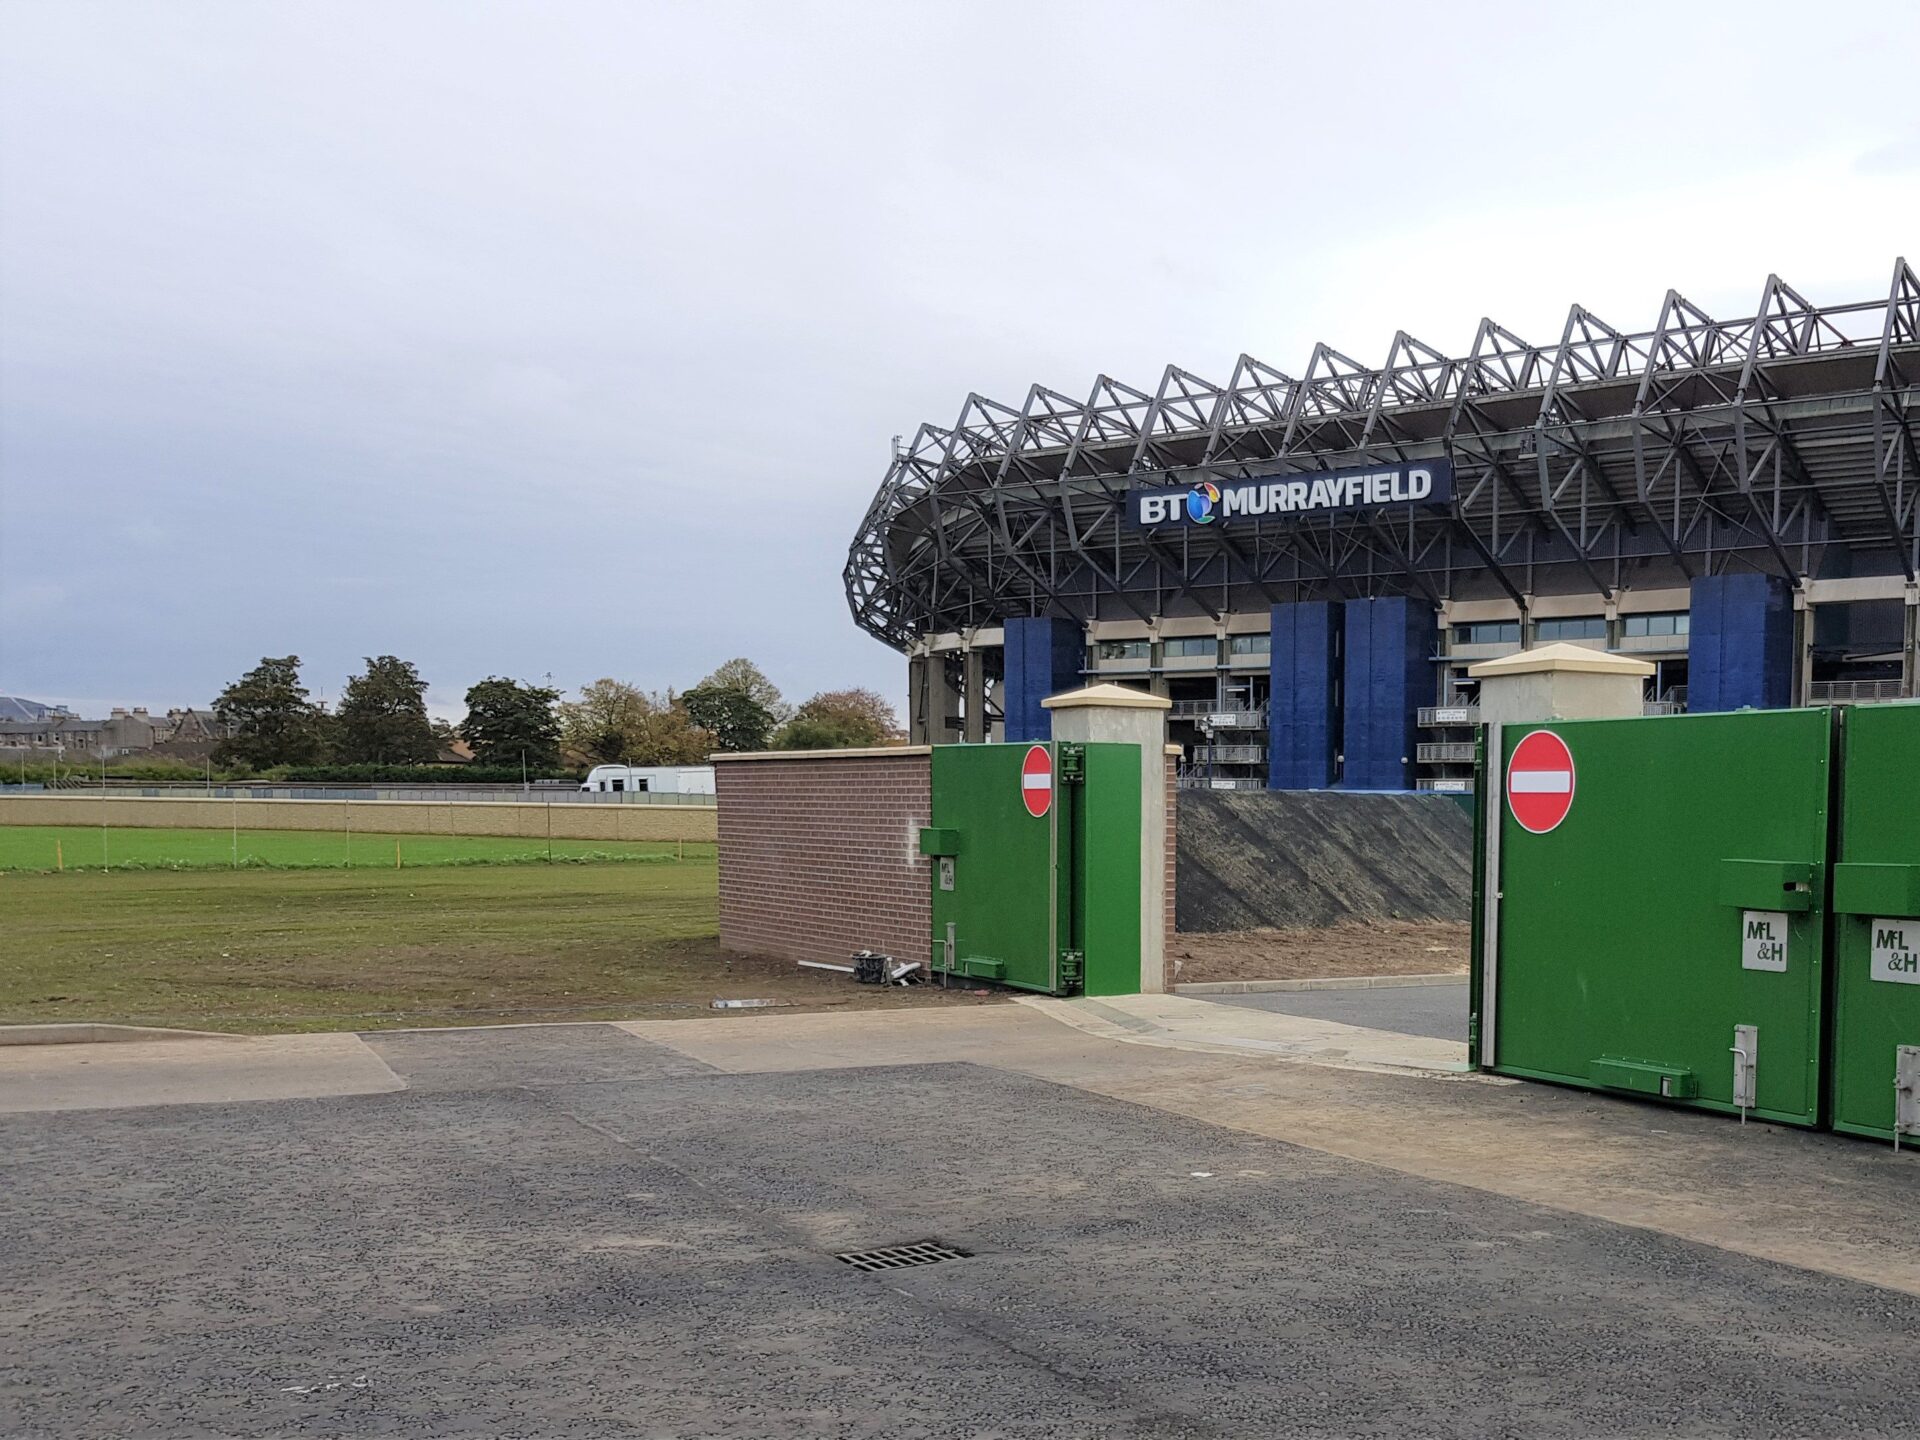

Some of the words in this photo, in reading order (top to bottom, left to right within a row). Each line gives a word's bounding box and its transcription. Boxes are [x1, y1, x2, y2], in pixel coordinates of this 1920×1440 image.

[1139, 493, 1188, 525] BT
[1222, 469, 1433, 518] MURRAYFIELD
[1757, 942, 1784, 962] &H
[1887, 952, 1918, 973] &H
